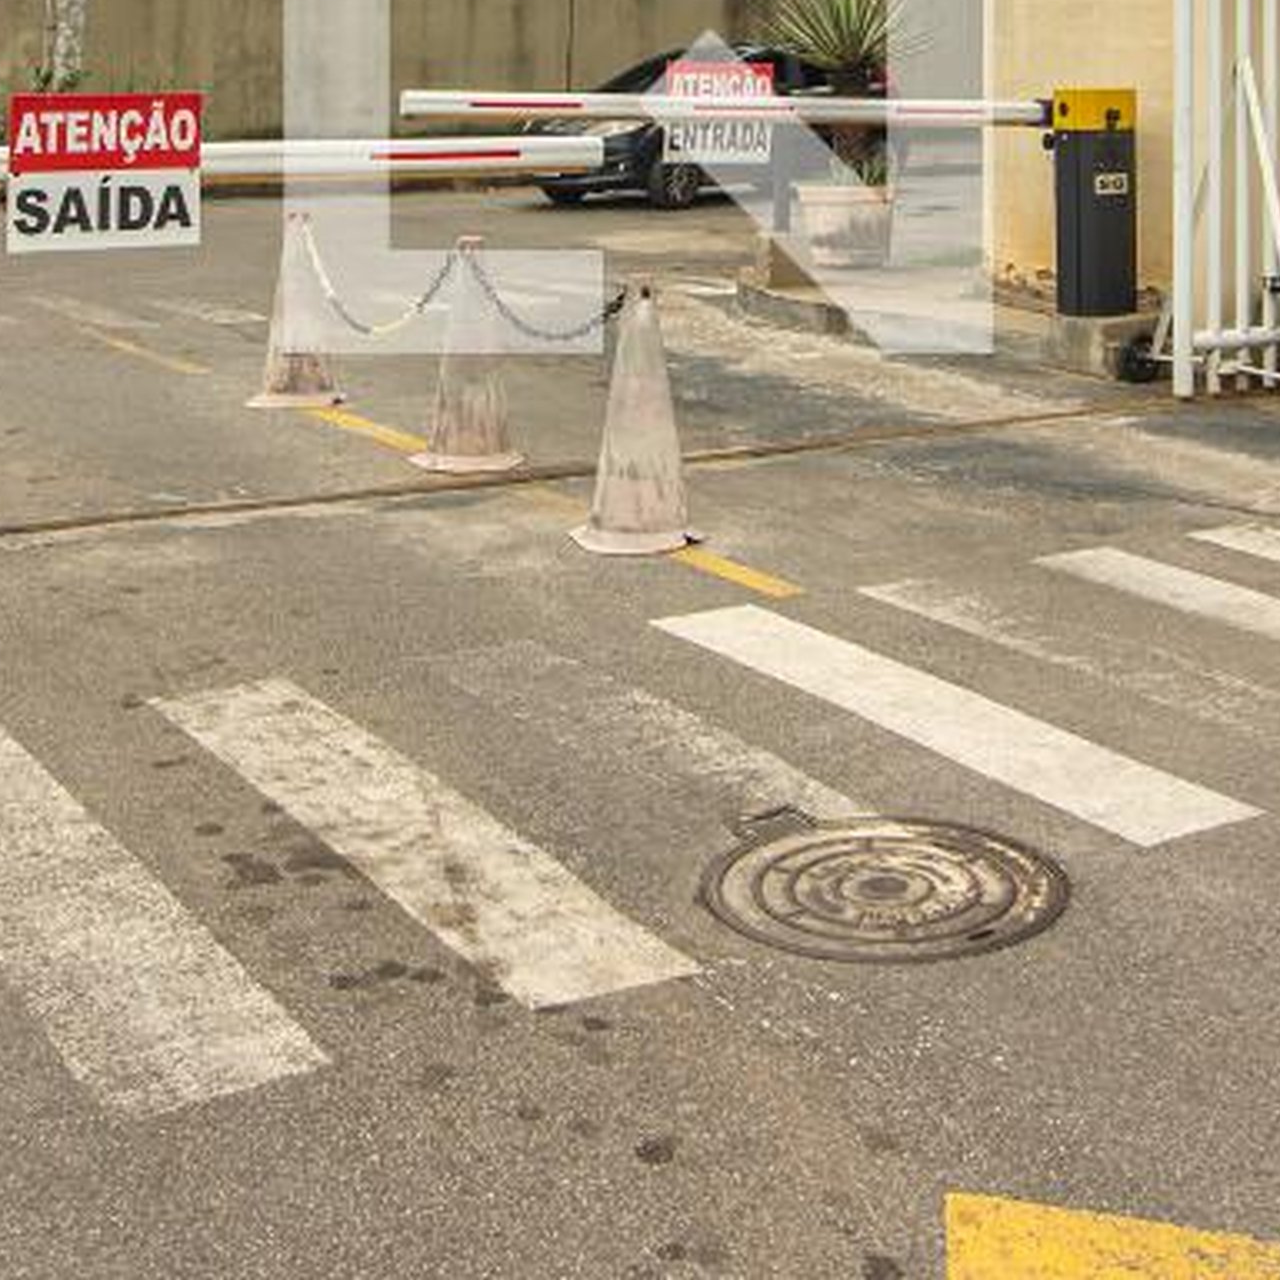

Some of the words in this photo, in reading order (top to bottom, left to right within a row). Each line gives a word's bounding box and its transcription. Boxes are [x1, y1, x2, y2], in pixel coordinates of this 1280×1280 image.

[14, 101, 198, 163] ATENÇÃO
[668, 120, 770, 152] ENTRADA
[13, 176, 192, 235] SAÍDA
